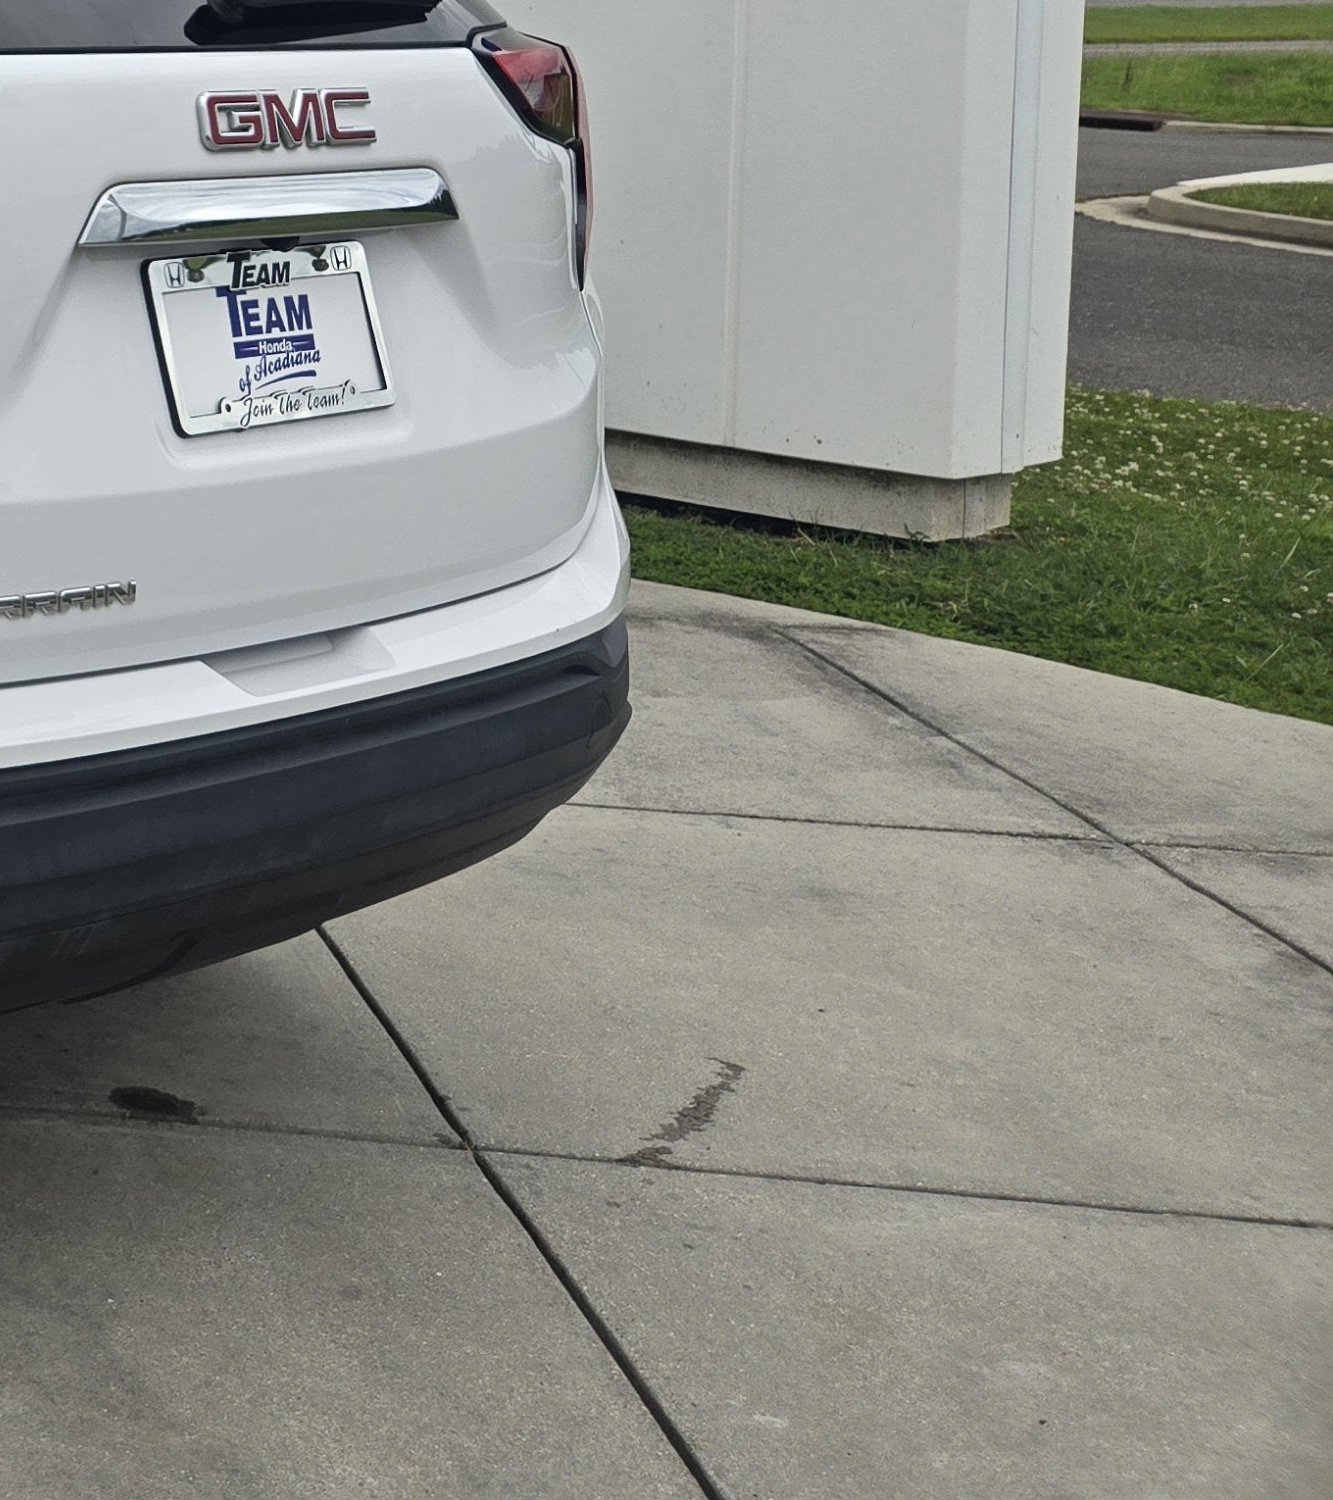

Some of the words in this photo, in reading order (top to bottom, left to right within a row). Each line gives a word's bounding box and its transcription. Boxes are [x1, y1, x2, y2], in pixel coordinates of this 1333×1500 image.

[196, 86, 377, 153] GMC
[227, 252, 290, 289] TEAM
[216, 287, 313, 338] TEAM
[258, 338, 293, 354] Honda
[239, 365, 252, 395] of
[240, 397, 274, 427] Join
[274, 391, 302, 415] The
